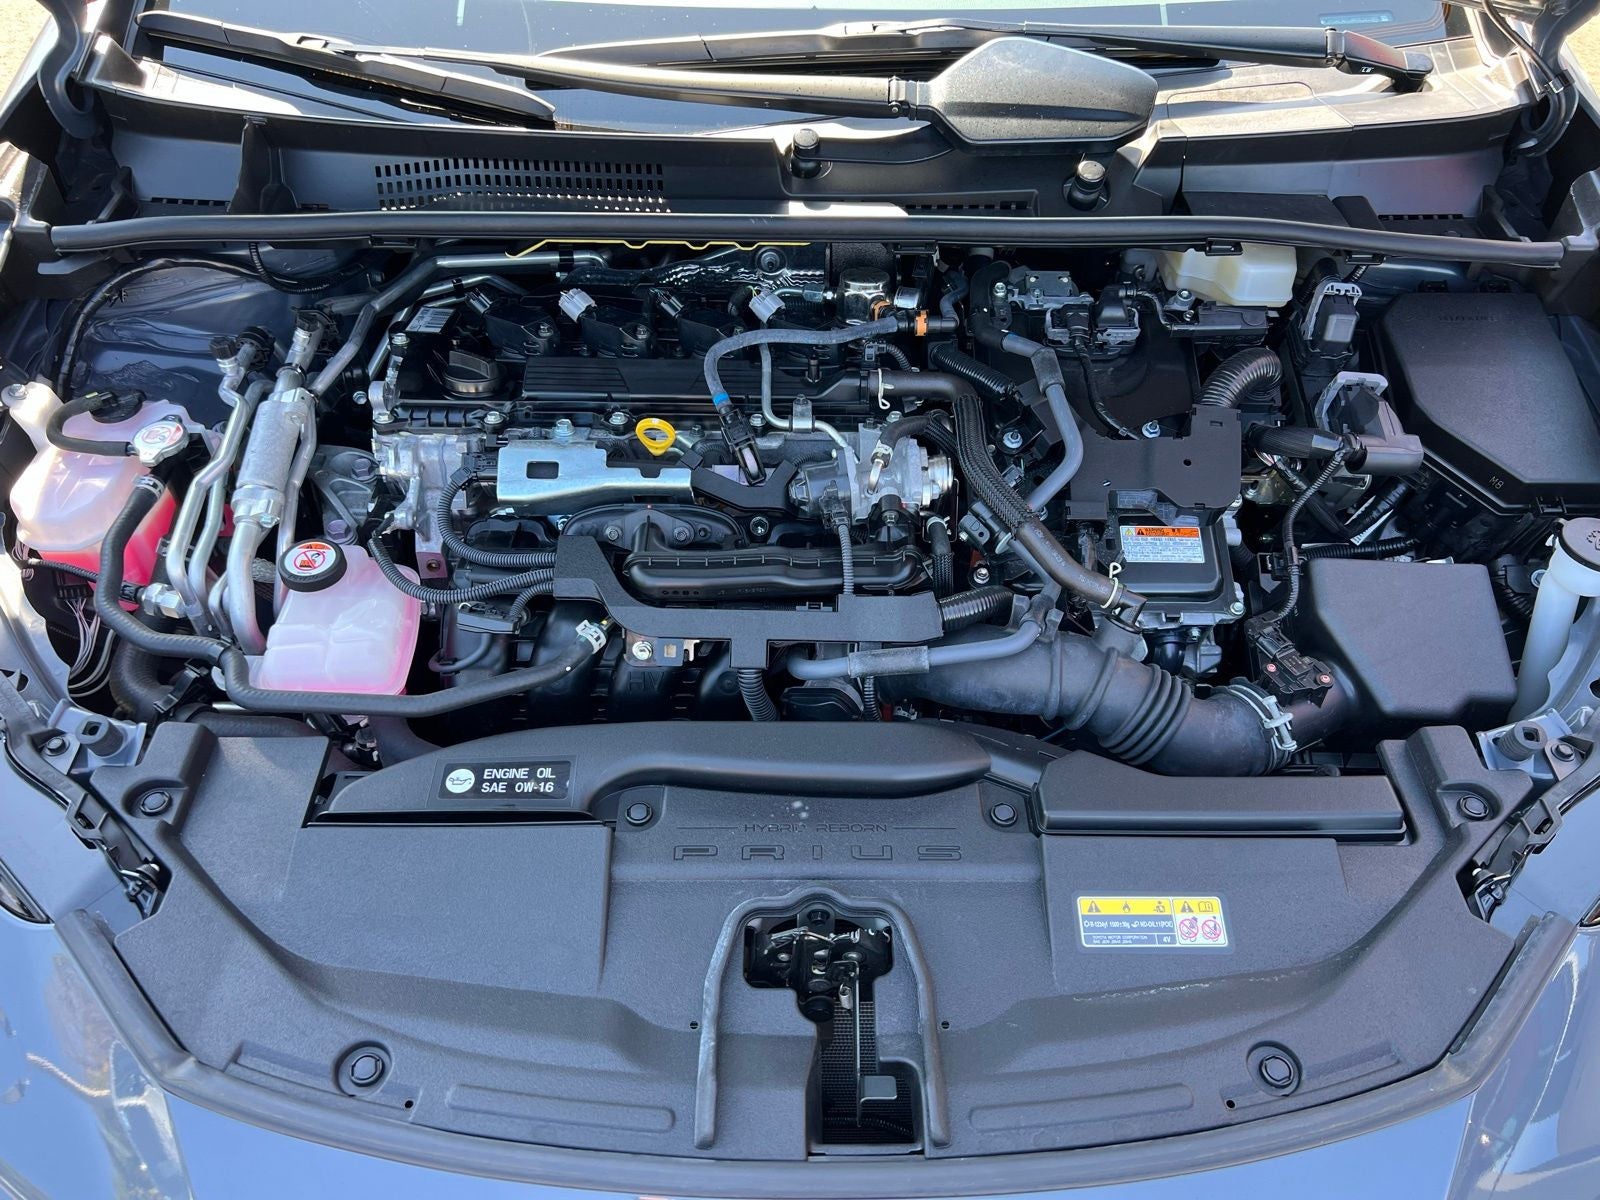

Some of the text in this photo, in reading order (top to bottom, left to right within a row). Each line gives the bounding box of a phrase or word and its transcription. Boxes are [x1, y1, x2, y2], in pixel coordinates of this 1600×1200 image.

[483, 768, 557, 779] ENGINE OIL
[481, 782, 555, 793] SAE 0W-16
[744, 823, 888, 832] HYBRID REBORN
[673, 845, 962, 861] PRIUS
